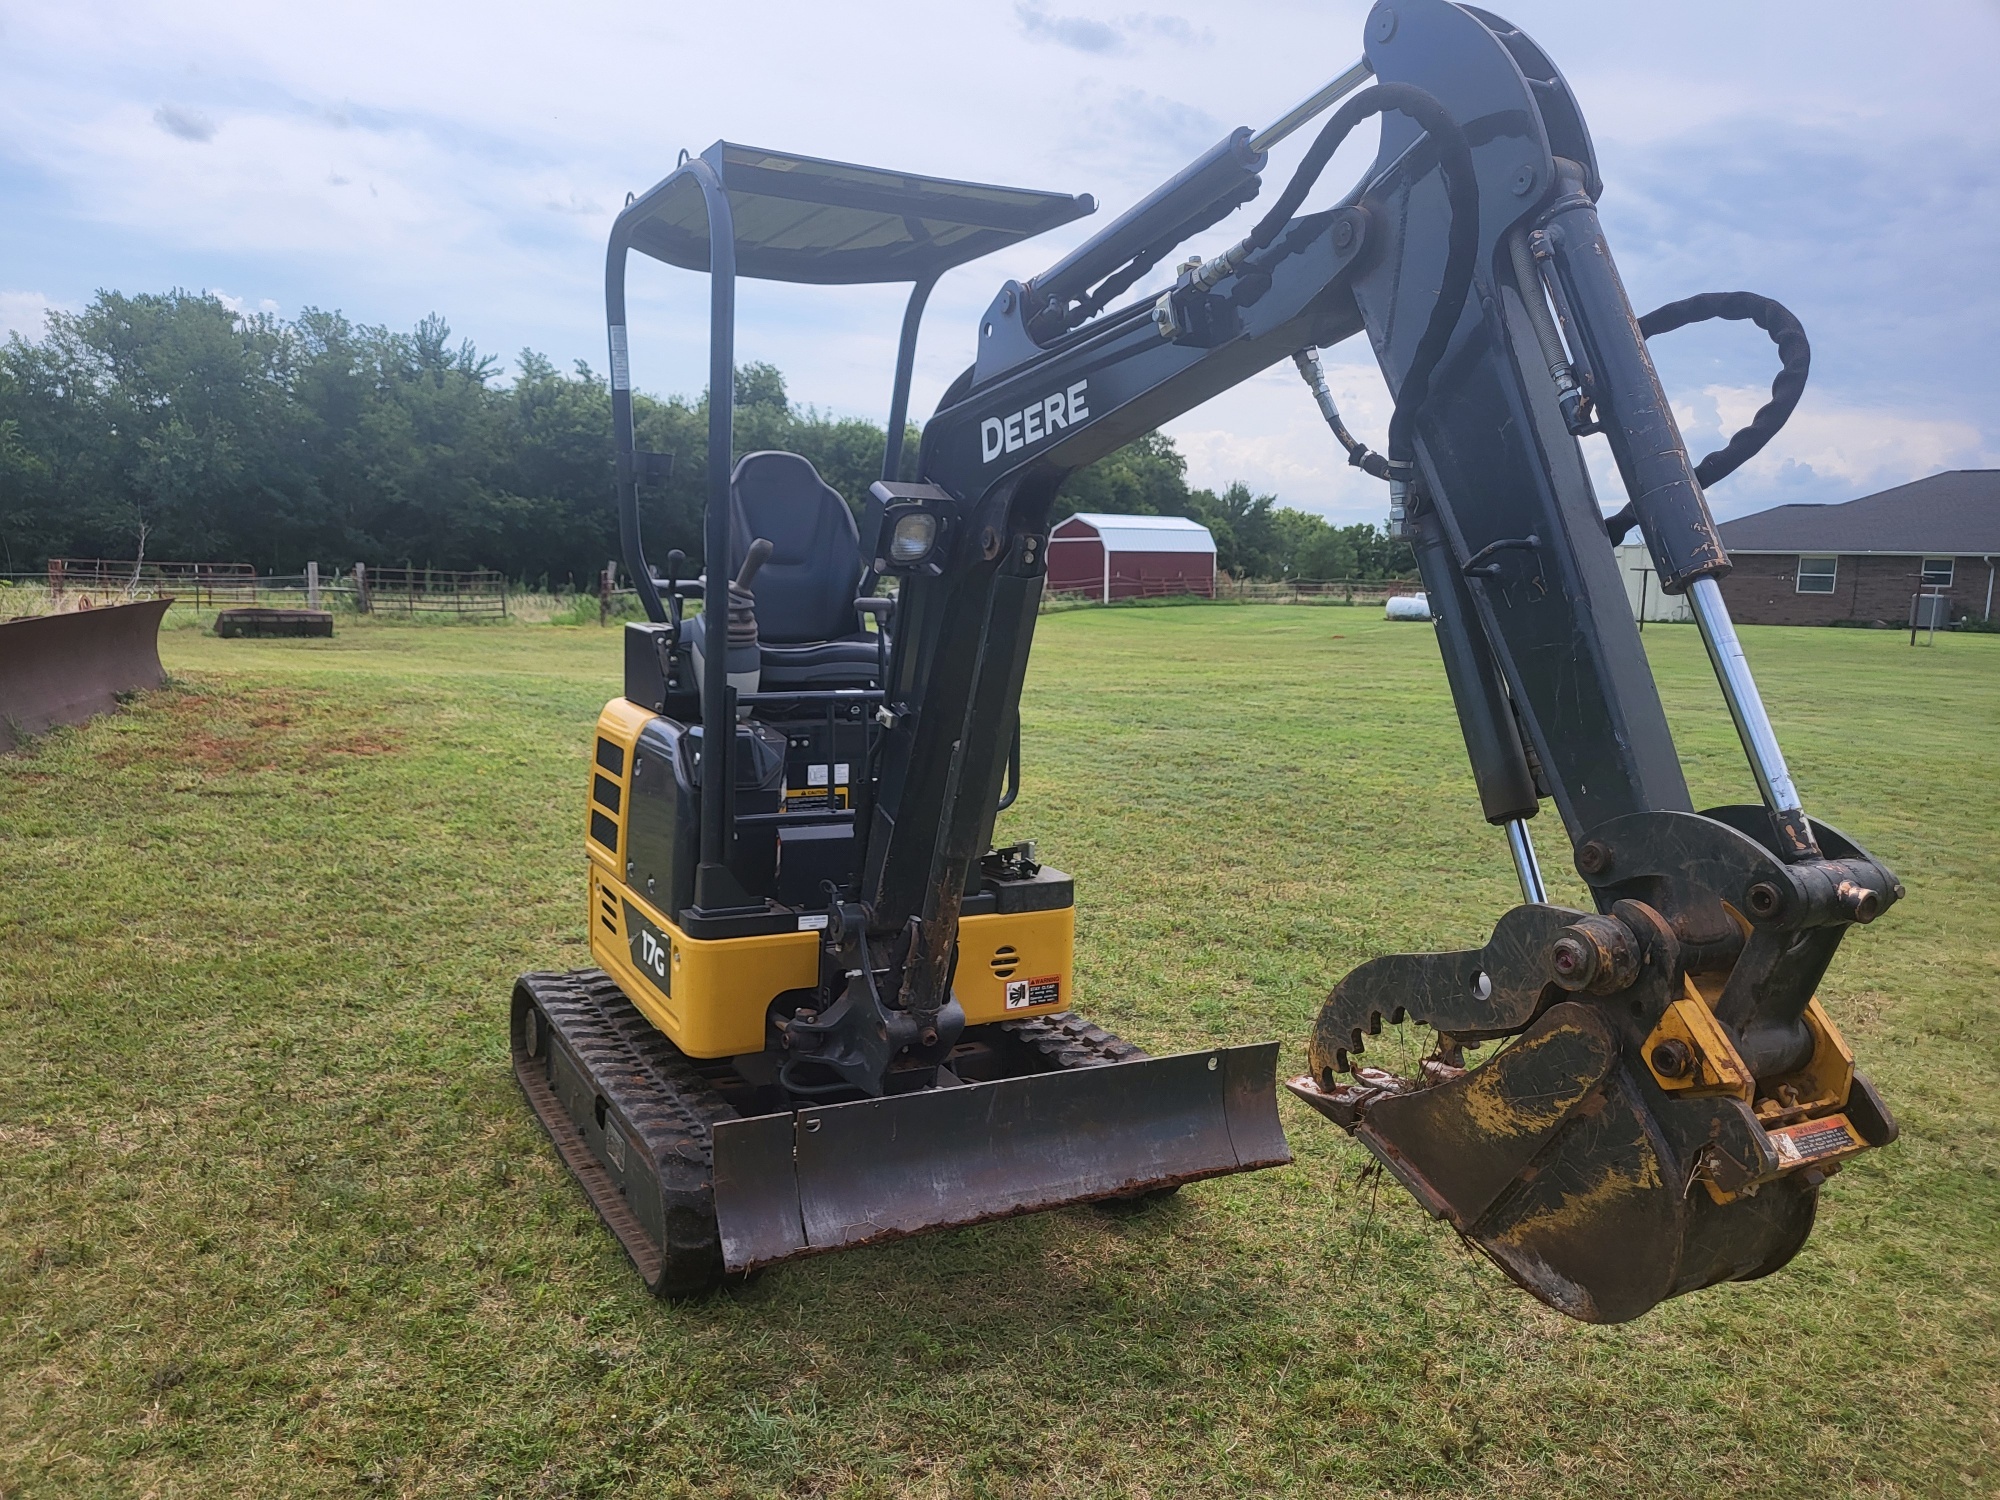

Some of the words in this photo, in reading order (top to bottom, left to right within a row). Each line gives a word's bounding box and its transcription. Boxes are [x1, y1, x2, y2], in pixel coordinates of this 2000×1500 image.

[981, 378, 1089, 464] DEERE
[642, 929, 665, 977] 17G
[1035, 976, 1060, 985] WARNING
